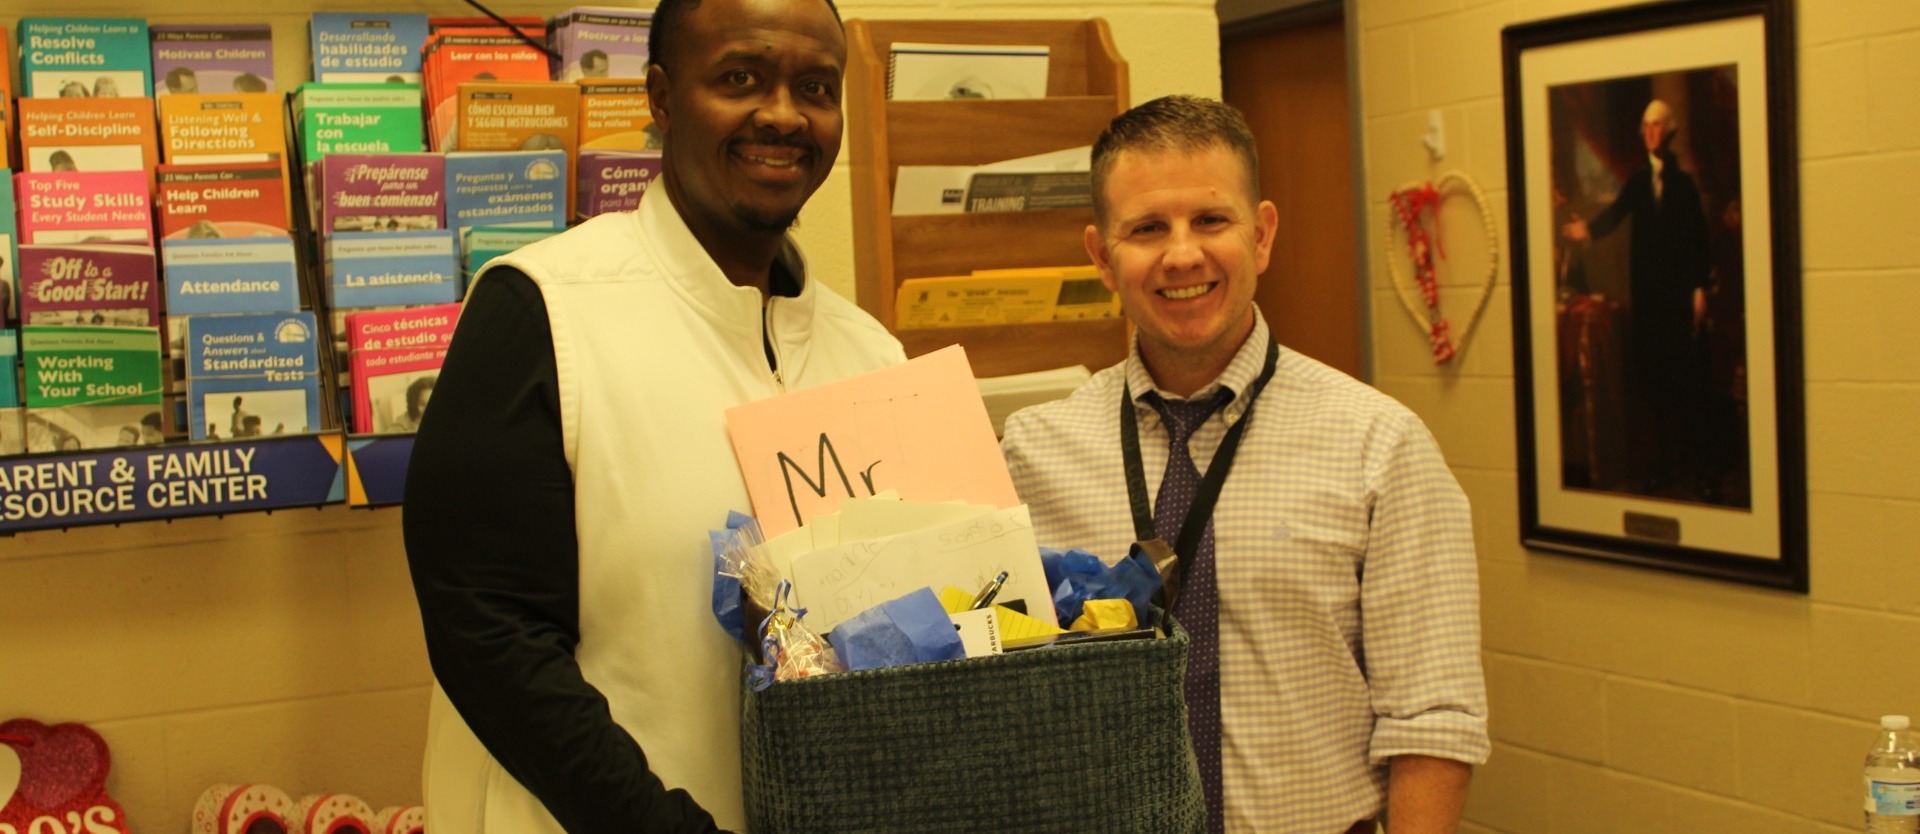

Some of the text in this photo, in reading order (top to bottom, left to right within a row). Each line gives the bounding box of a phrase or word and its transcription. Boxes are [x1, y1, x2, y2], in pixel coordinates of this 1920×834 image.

[29, 24, 139, 35] Helping Children Learn to
[577, 30, 620, 42] Motivar
[623, 34, 630, 42] a
[30, 36, 95, 50] Resolve
[320, 31, 396, 43] Desarrollando
[159, 49, 266, 60] Motivate Children
[320, 43, 408, 55] habilidades
[450, 50, 538, 61] Leer con los niños
[31, 51, 105, 65] Conflicts
[321, 56, 402, 68] de estudio
[468, 102, 555, 116] CÓMO ESCUCHAR BIEN
[588, 98, 645, 108] Desarrollar
[27, 110, 135, 122] Helping Children Learn
[169, 113, 262, 125] Listening Well &
[315, 112, 381, 128] Trabajar
[468, 116, 568, 128] Y SEGUIR INSTRUCCIONES
[588, 118, 632, 128] los niños
[27, 124, 141, 139] Self-Discipline
[170, 125, 248, 139] Following
[316, 128, 343, 139] con
[172, 138, 256, 150] Directions
[317, 140, 390, 153] la escuela
[350, 164, 428, 183] ¡Prepárense
[456, 173, 514, 185] Preguntas y
[601, 166, 649, 180] Cómo
[29, 180, 80, 191] Top Five
[381, 181, 418, 192] para un
[456, 183, 509, 194] respuestas
[31, 193, 144, 211] Study Skills
[167, 188, 259, 202] Help Children
[339, 191, 439, 208] buen comienzo!
[488, 190, 554, 204] exámenes
[168, 203, 207, 215] Learn
[458, 203, 554, 218] estandarizados
[971, 196, 1025, 212] TRAINING
[32, 210, 146, 224] Every Student Needs
[50, 256, 113, 280] Off to a
[346, 272, 443, 287] La asistencia
[37, 278, 149, 303] Good Start!
[180, 279, 280, 295] Attendance
[362, 315, 449, 335] Cinco técnicas
[202, 333, 265, 346] Questions &
[364, 338, 382, 351] de
[385, 333, 437, 348] estudio
[203, 346, 249, 357] Answers
[37, 355, 113, 370] Working
[203, 355, 304, 372] Standardized
[366, 357, 387, 367] todo
[389, 352, 434, 364] estudiante
[37, 370, 83, 384] With
[263, 370, 305, 383] Tests
[38, 384, 143, 398] Your School
[0, 447, 256, 492] ARENT & FAMILY
[0, 474, 268, 520] SOURCE CENTER
[986, 614, 998, 653] ARBUCKS
